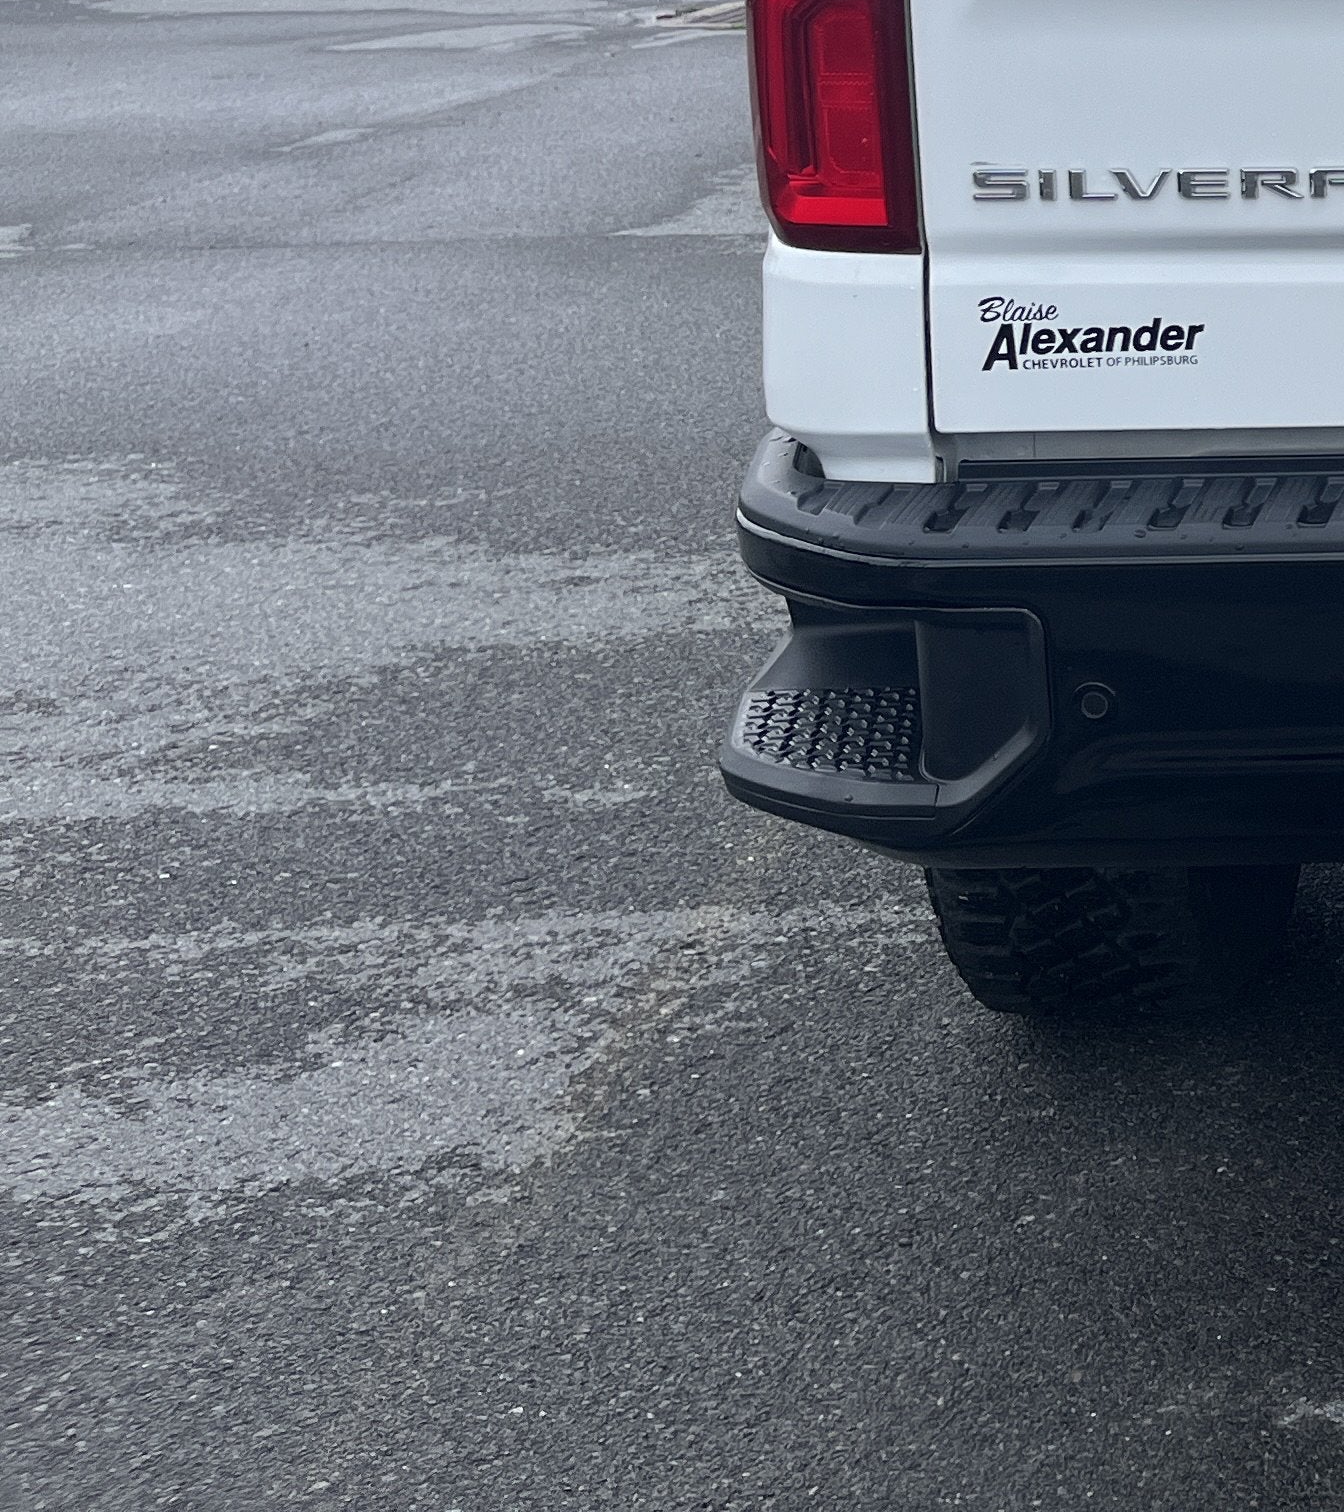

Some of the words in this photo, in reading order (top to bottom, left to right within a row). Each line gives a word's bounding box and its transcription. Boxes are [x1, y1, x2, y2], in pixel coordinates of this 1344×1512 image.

[978, 297, 1059, 322] Blaise
[982, 318, 1205, 371] Alexander
[1023, 357, 1102, 370] CHEVROLET
[1106, 356, 1122, 367] OF
[1124, 355, 1198, 367] PHILIPSBURG
